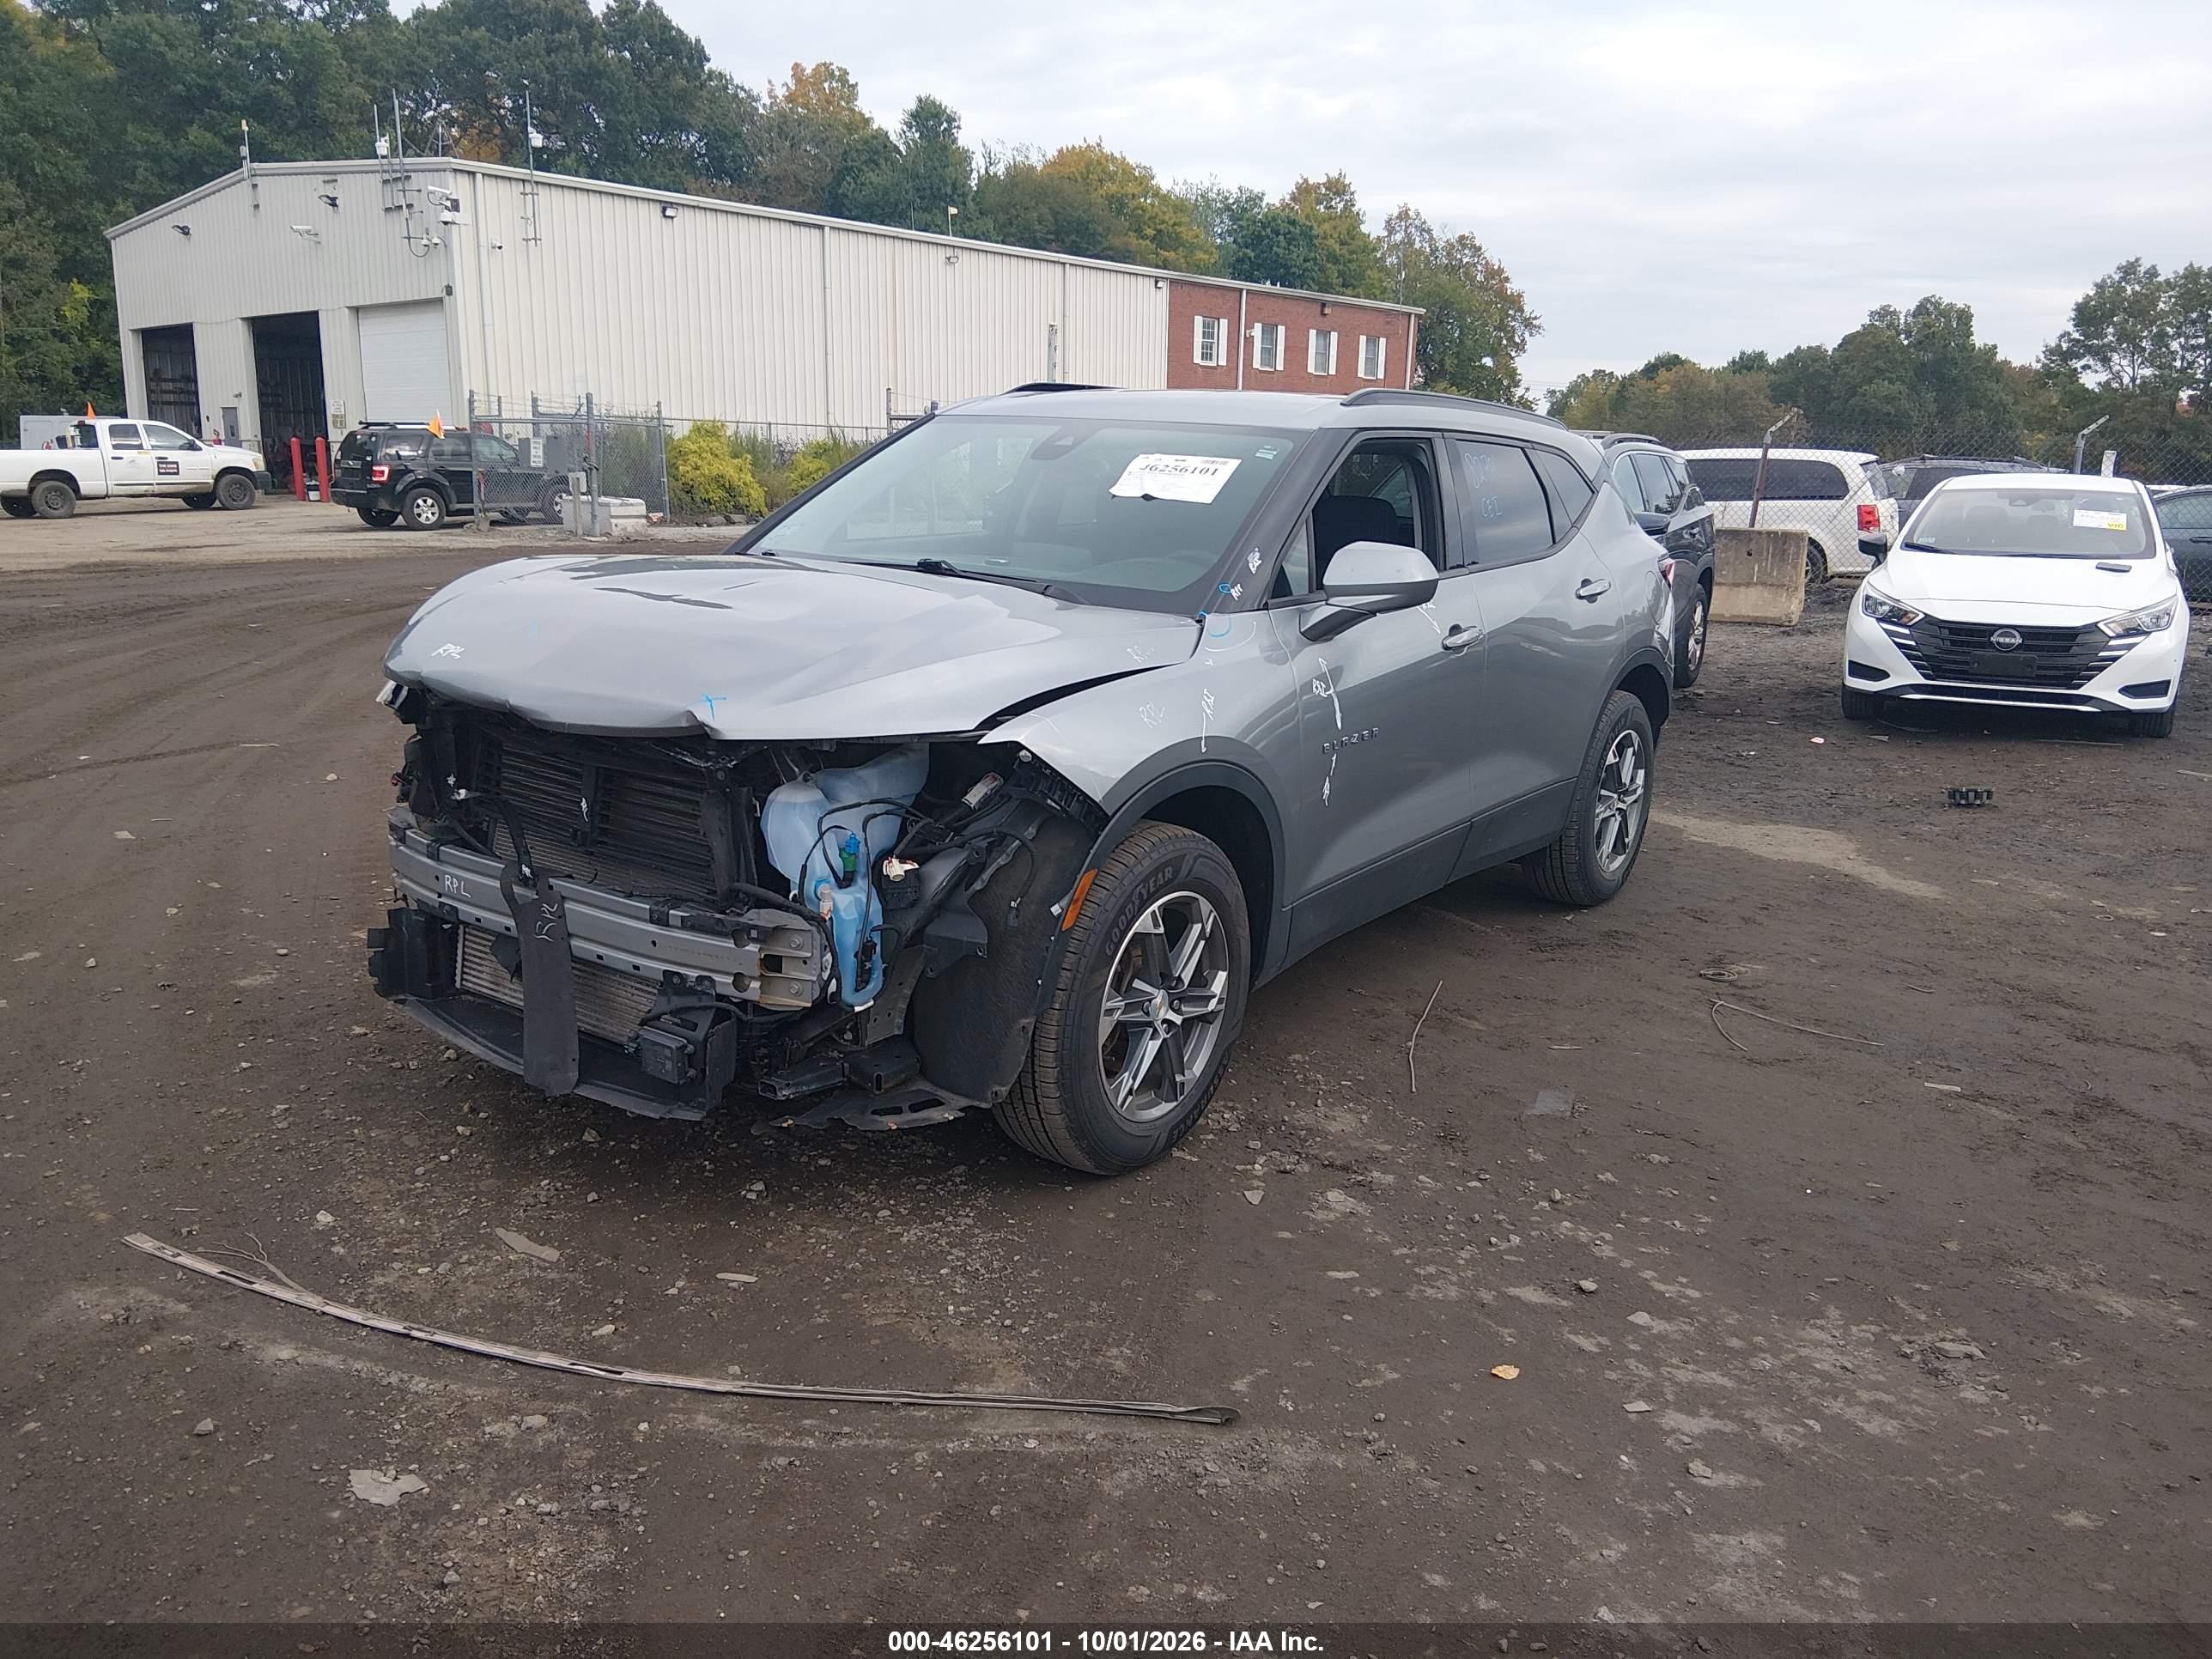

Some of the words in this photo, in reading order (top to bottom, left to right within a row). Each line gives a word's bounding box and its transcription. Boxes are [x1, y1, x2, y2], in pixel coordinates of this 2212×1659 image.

[1322, 727, 1380, 755] BLAZER
[444, 874, 472, 898] RPL
[1105, 866, 1174, 957] GOODYEAR
